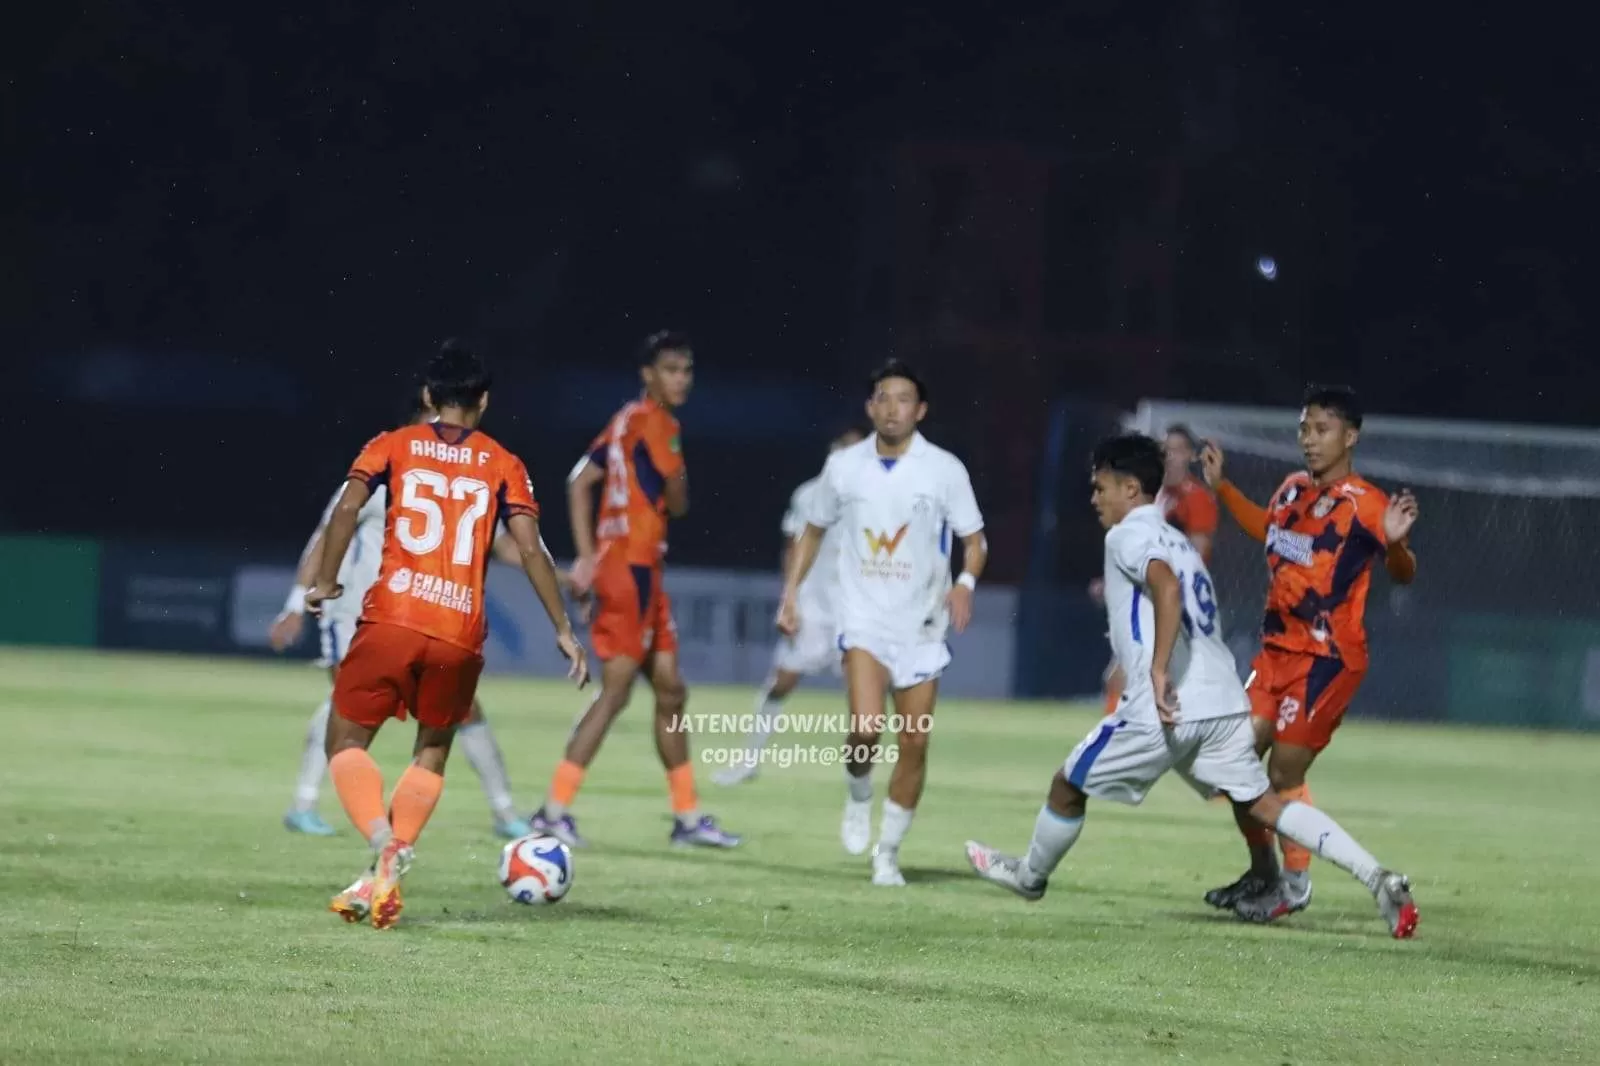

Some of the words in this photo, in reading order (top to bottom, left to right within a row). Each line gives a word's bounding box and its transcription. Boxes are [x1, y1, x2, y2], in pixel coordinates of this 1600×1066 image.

[410, 440, 472, 465] AKBAR
[478, 451, 491, 467] F
[395, 468, 490, 566] 57
[413, 572, 473, 604] CHARLIE
